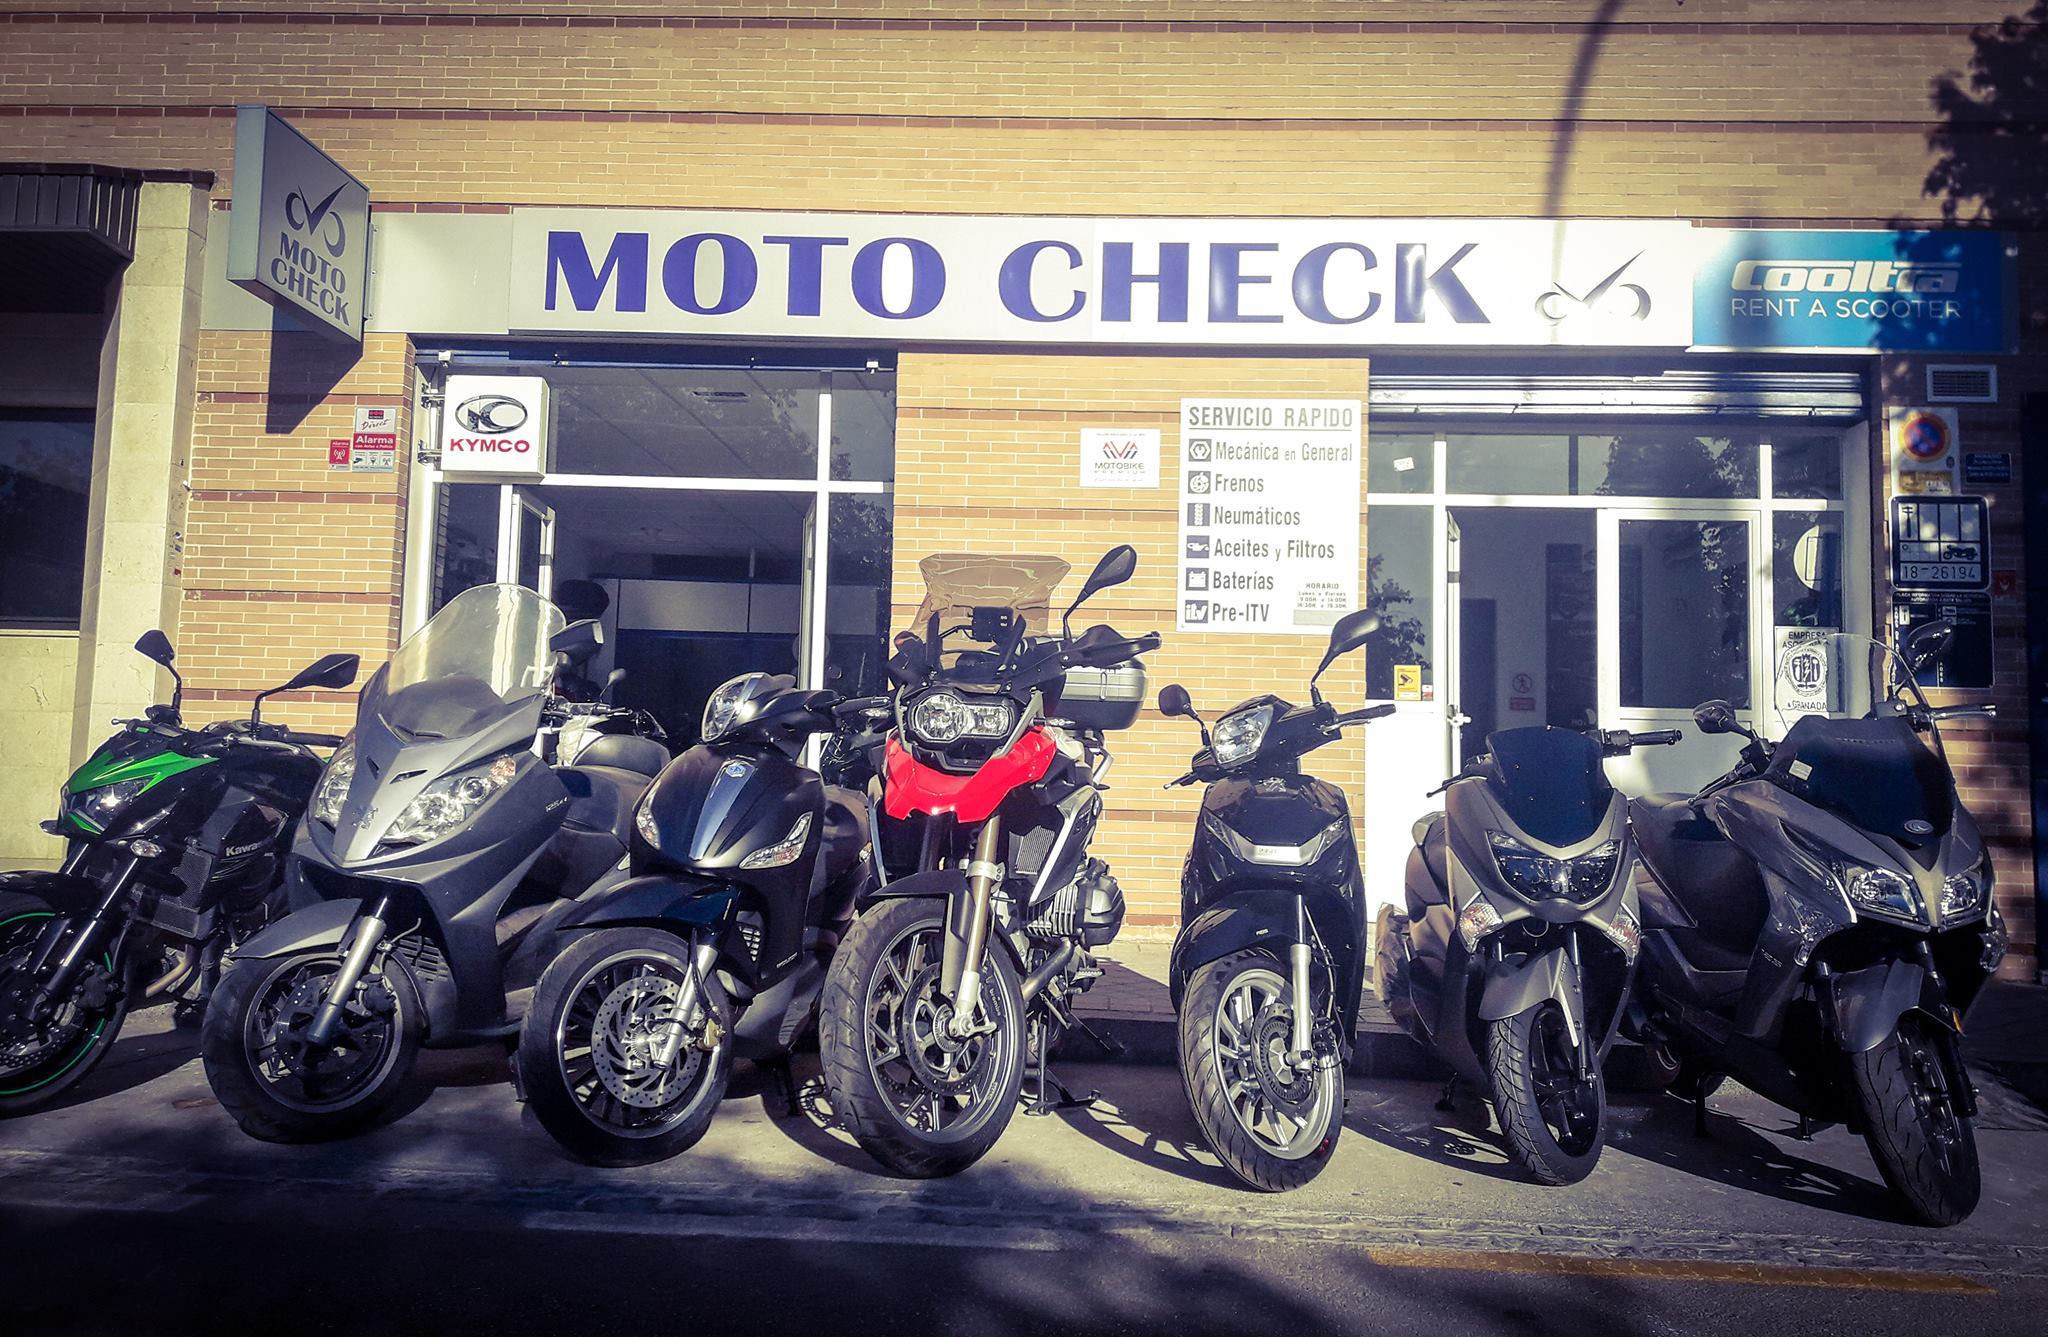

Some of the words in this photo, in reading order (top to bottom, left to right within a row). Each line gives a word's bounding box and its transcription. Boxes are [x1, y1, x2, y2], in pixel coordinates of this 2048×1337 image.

[280, 231, 346, 294] MOTO
[543, 231, 948, 320] MOTO
[998, 239, 1491, 325] CHECK
[1731, 260, 1962, 293] Cooltra
[271, 257, 350, 326] CHECK
[1731, 298, 1800, 318] RENT
[1808, 299, 1828, 318] A
[1836, 299, 1962, 319] SCOOTER
[1188, 406, 1273, 427] SERVICIO
[1283, 407, 1353, 428] RAPIDO
[355, 435, 394, 444] Alarma
[450, 438, 530, 453] KYMCO
[1215, 441, 1280, 461] Mecánica
[1284, 449, 1296, 461] en
[1301, 442, 1353, 462] General
[1094, 462, 1145, 470] MOTOBIKE
[1214, 473, 1265, 493] Frenos
[1214, 505, 1301, 527] Neumáticos
[1214, 538, 1269, 559] Aceites
[1274, 547, 1282, 562] y
[1287, 539, 1335, 560] Filtros
[1212, 570, 1275, 591] Baterías
[1904, 565, 1976, 580] 18-26194
[1212, 603, 1270, 623] Pre-ITV
[1788, 631, 1826, 640] EMPRESA
[1792, 700, 1827, 711] GRANADA
